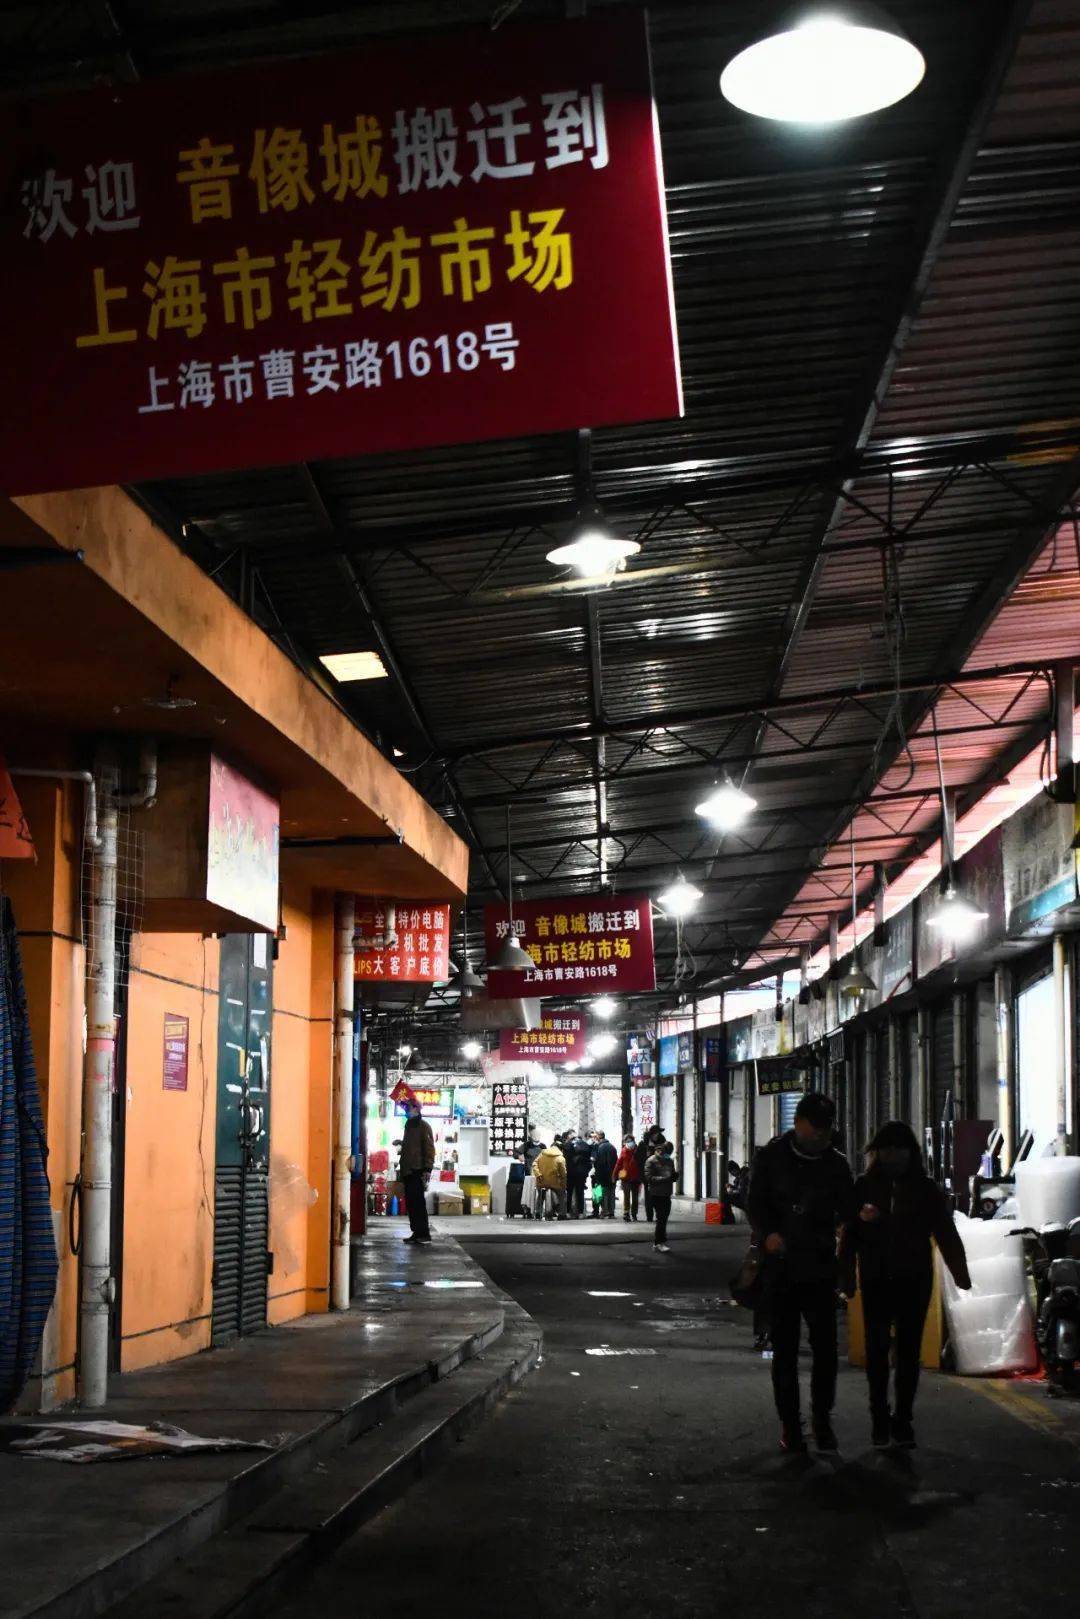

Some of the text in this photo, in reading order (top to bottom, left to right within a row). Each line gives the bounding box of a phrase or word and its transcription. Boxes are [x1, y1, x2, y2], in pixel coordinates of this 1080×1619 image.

[20, 84, 610, 243] 欢迎 音像城搬迁到
[75, 207, 574, 349] 上海市轻纺市场
[138, 321, 520, 415] 上海市曹安路1618号
[375, 908, 445, 931] 全特价电脑
[495, 909, 640, 938] 欢迎 音像城搬迁到
[526, 937, 632, 965] 海市轻纺市场
[639, 1094, 654, 1132] 信号放
